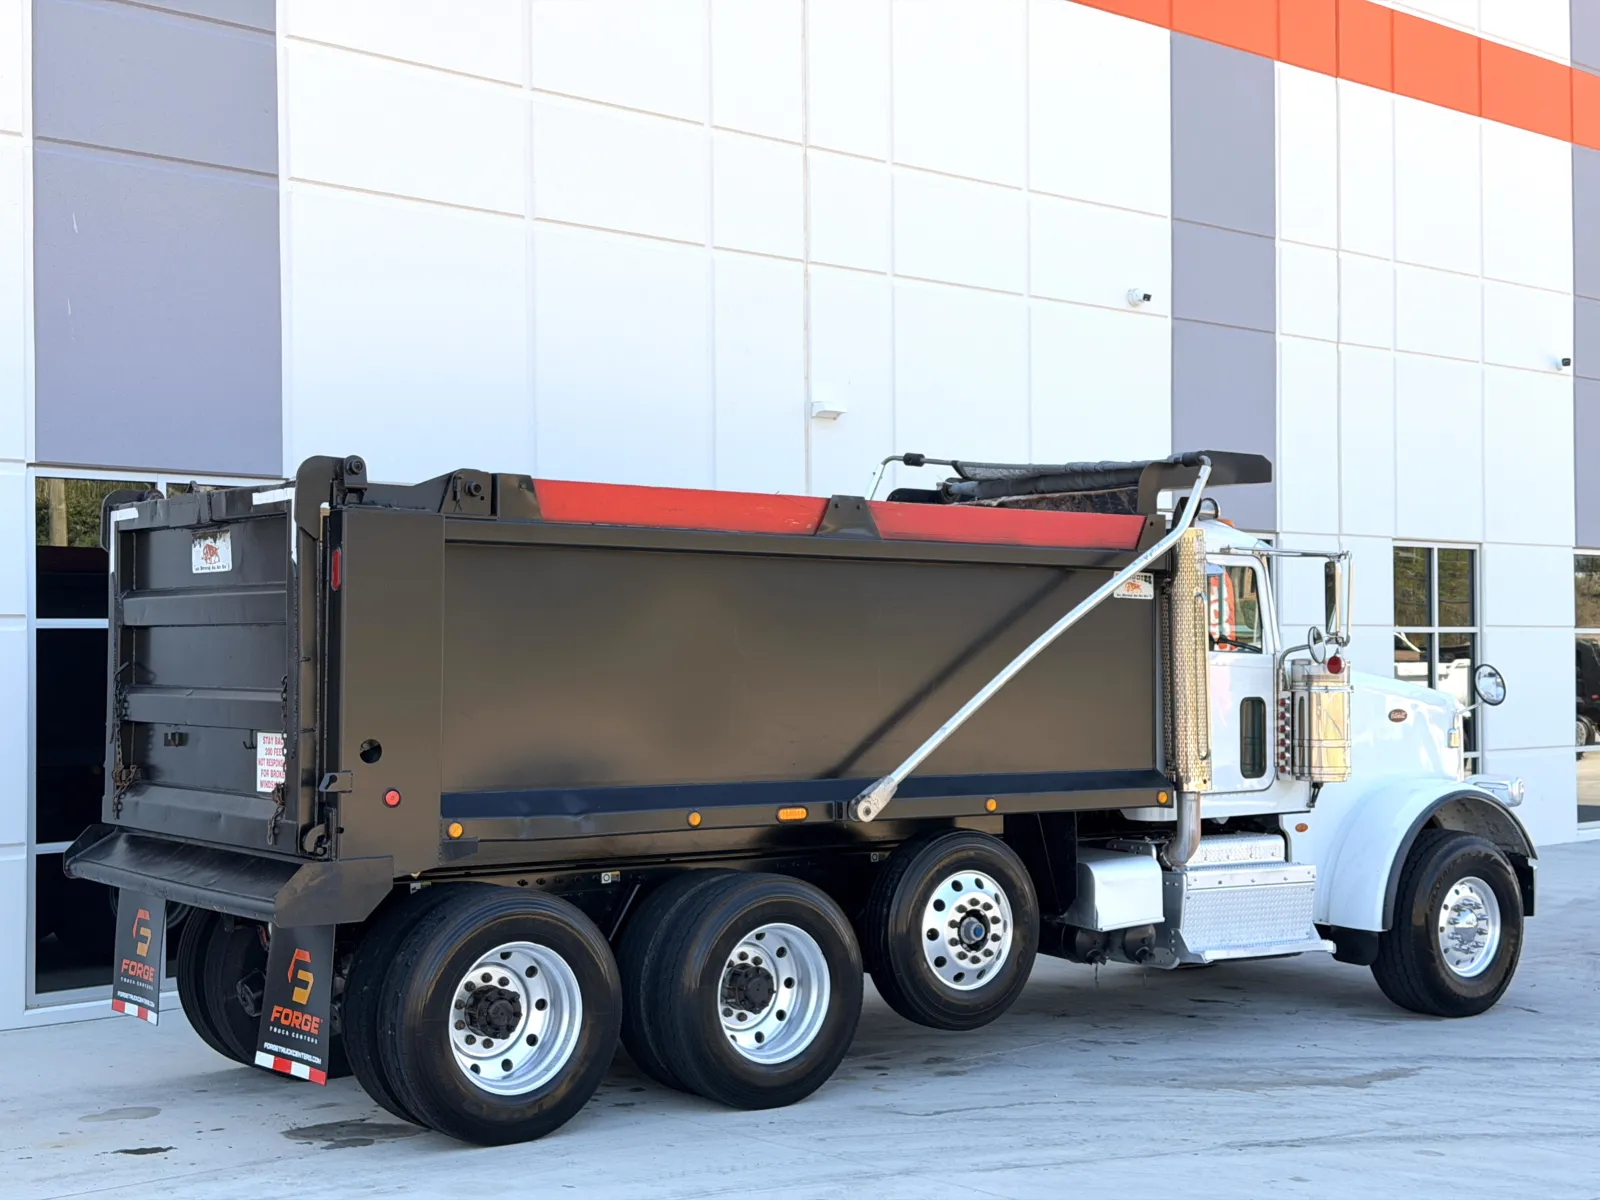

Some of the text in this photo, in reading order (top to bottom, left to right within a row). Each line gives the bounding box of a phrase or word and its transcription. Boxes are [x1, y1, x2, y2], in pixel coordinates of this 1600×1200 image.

[263, 736, 284, 745] STAY BAC
[265, 747, 282, 756] 200 FEE
[258, 758, 285, 768] NOT RESPONS
[260, 769, 285, 779] FOR BROKE
[121, 958, 155, 983] FORGE
[270, 1005, 321, 1035] FORGE
[269, 1025, 289, 1036] TRUCK
